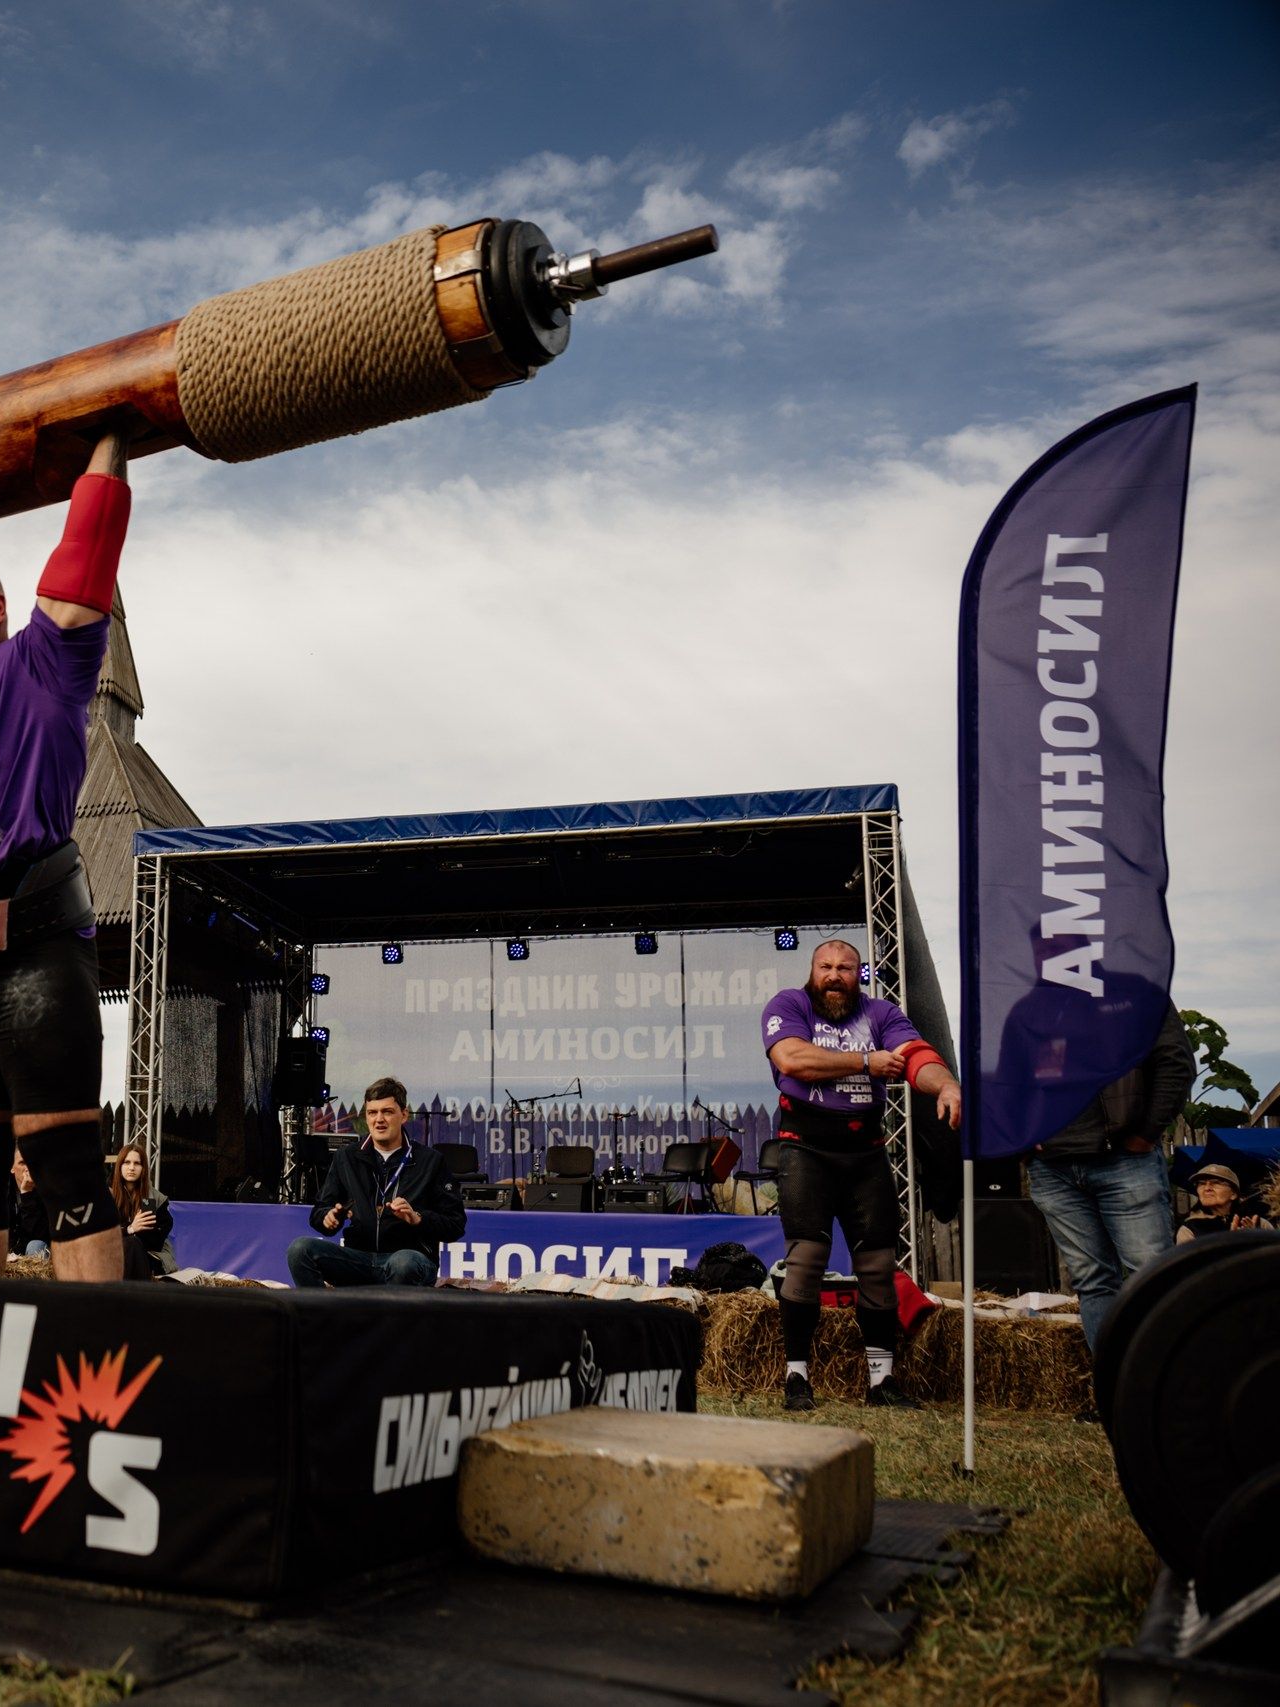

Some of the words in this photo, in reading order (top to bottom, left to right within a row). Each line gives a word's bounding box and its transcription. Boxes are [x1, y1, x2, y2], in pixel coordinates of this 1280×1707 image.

[1036, 531, 1109, 998] АМИНОСИЛ
[405, 975, 599, 1017] ПРАЗДНИК
[615, 968, 778, 1008] УРОЖАЯ
[449, 1025, 726, 1062] АМИНОСИЛ
